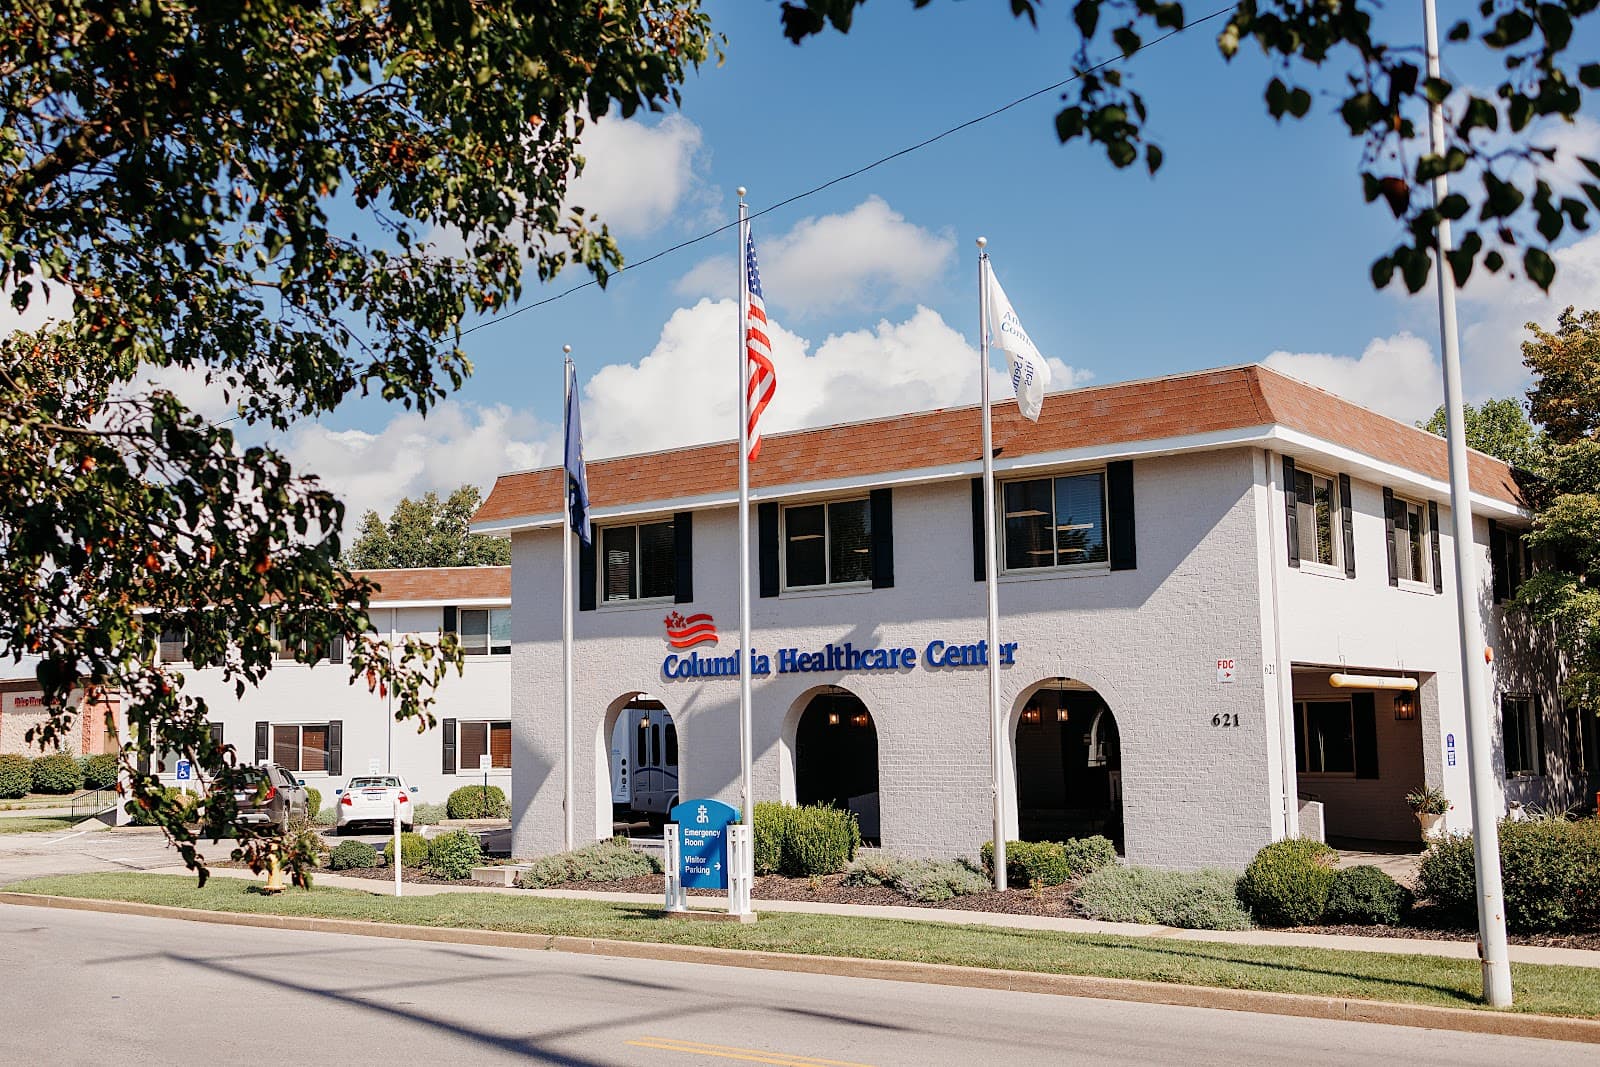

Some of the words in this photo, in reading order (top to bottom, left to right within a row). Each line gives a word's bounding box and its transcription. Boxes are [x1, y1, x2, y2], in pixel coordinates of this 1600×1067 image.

[777, 642, 917, 673] Healthcare
[1217, 660, 1234, 669] FDC
[1211, 713, 1240, 728] 621
[684, 828, 721, 838] Emergency
[684, 838, 704, 846] Room
[684, 855, 706, 864] Visitor
[685, 866, 711, 876] Parking
